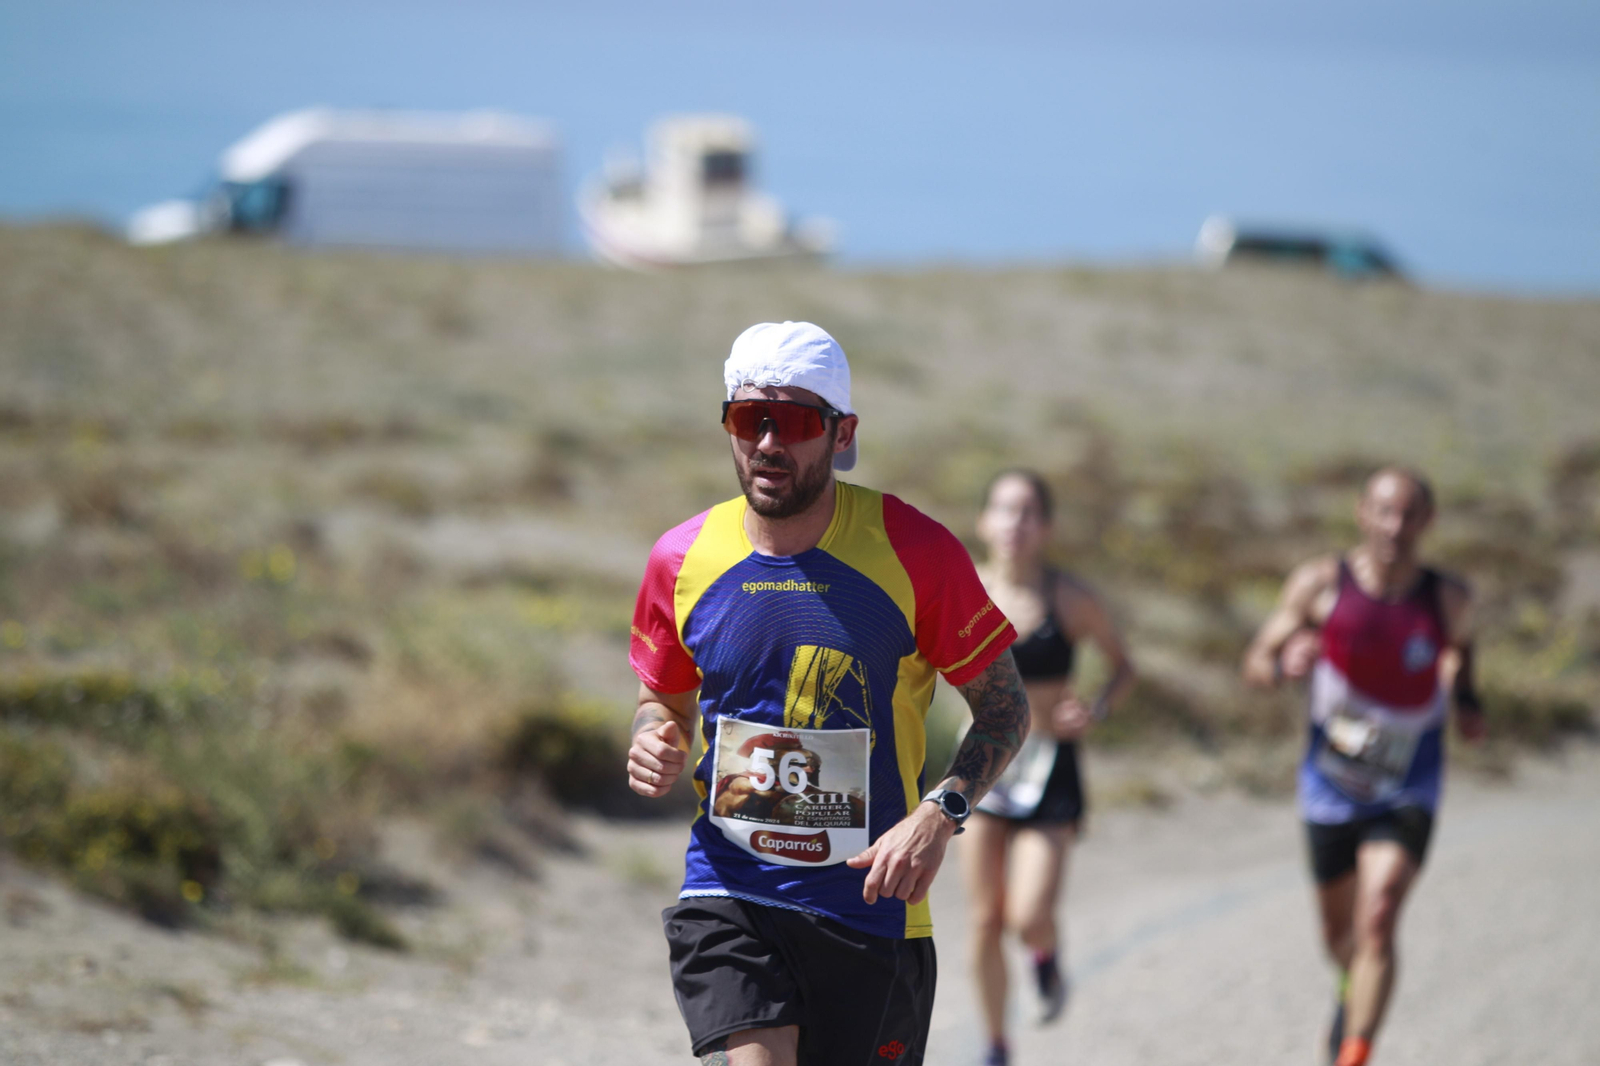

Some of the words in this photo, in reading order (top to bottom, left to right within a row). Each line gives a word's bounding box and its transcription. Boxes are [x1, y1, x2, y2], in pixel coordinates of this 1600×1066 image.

[742, 579, 831, 594] egomadhatter
[749, 747, 808, 794] 56
[797, 793, 851, 804] XIII
[878, 1039, 906, 1060] ego
